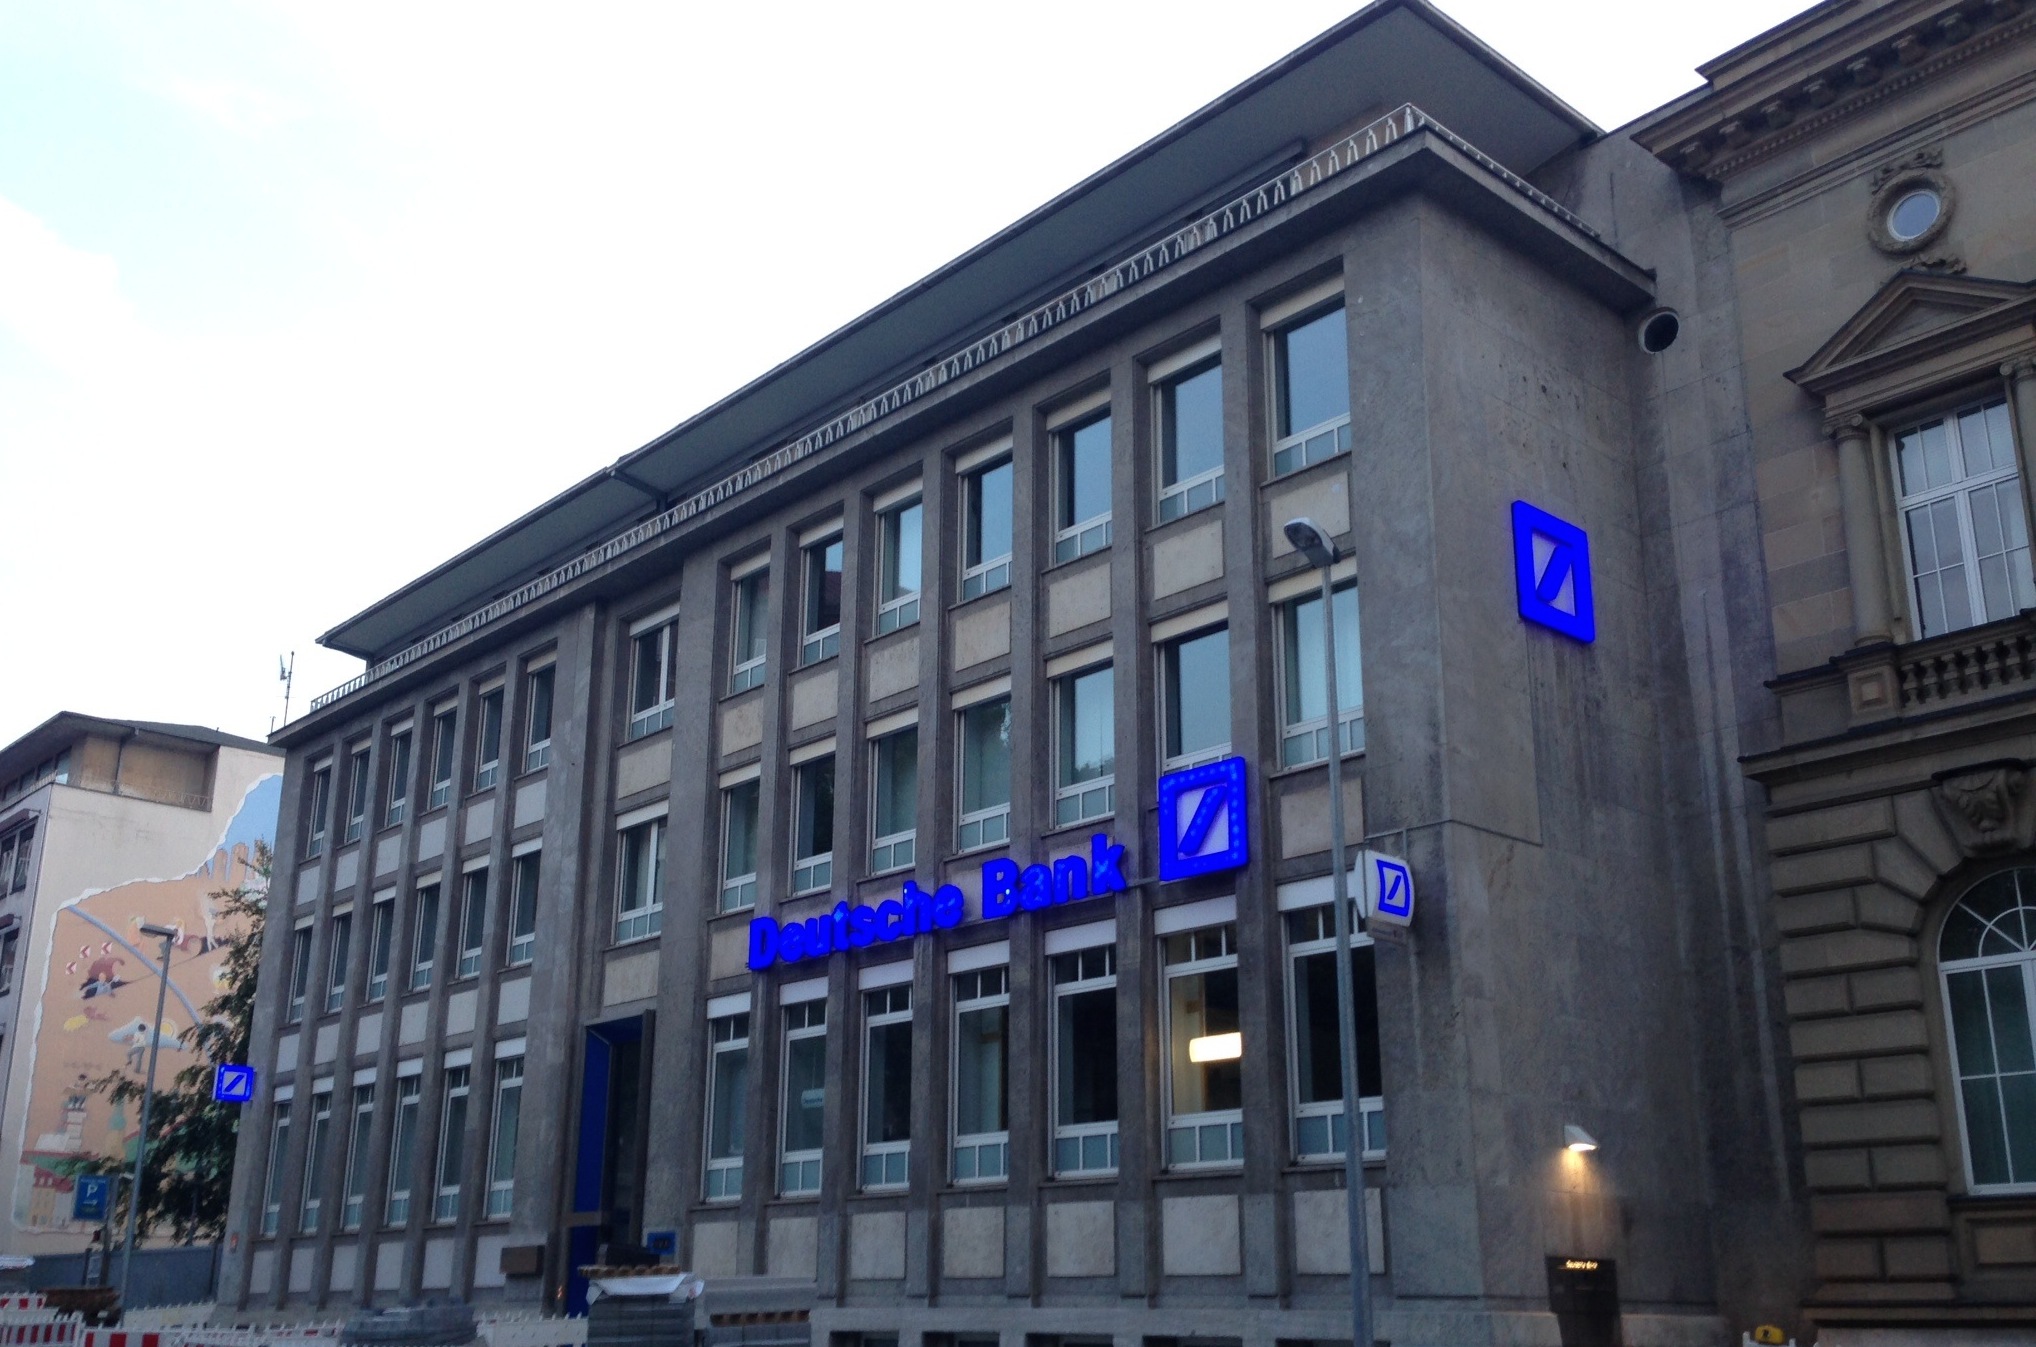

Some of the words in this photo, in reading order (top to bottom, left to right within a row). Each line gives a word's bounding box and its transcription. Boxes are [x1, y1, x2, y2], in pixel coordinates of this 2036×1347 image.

[748, 880, 965, 969] Deutsche
[981, 833, 1126, 920] Bank
[86, 1183, 99, 1198] P
